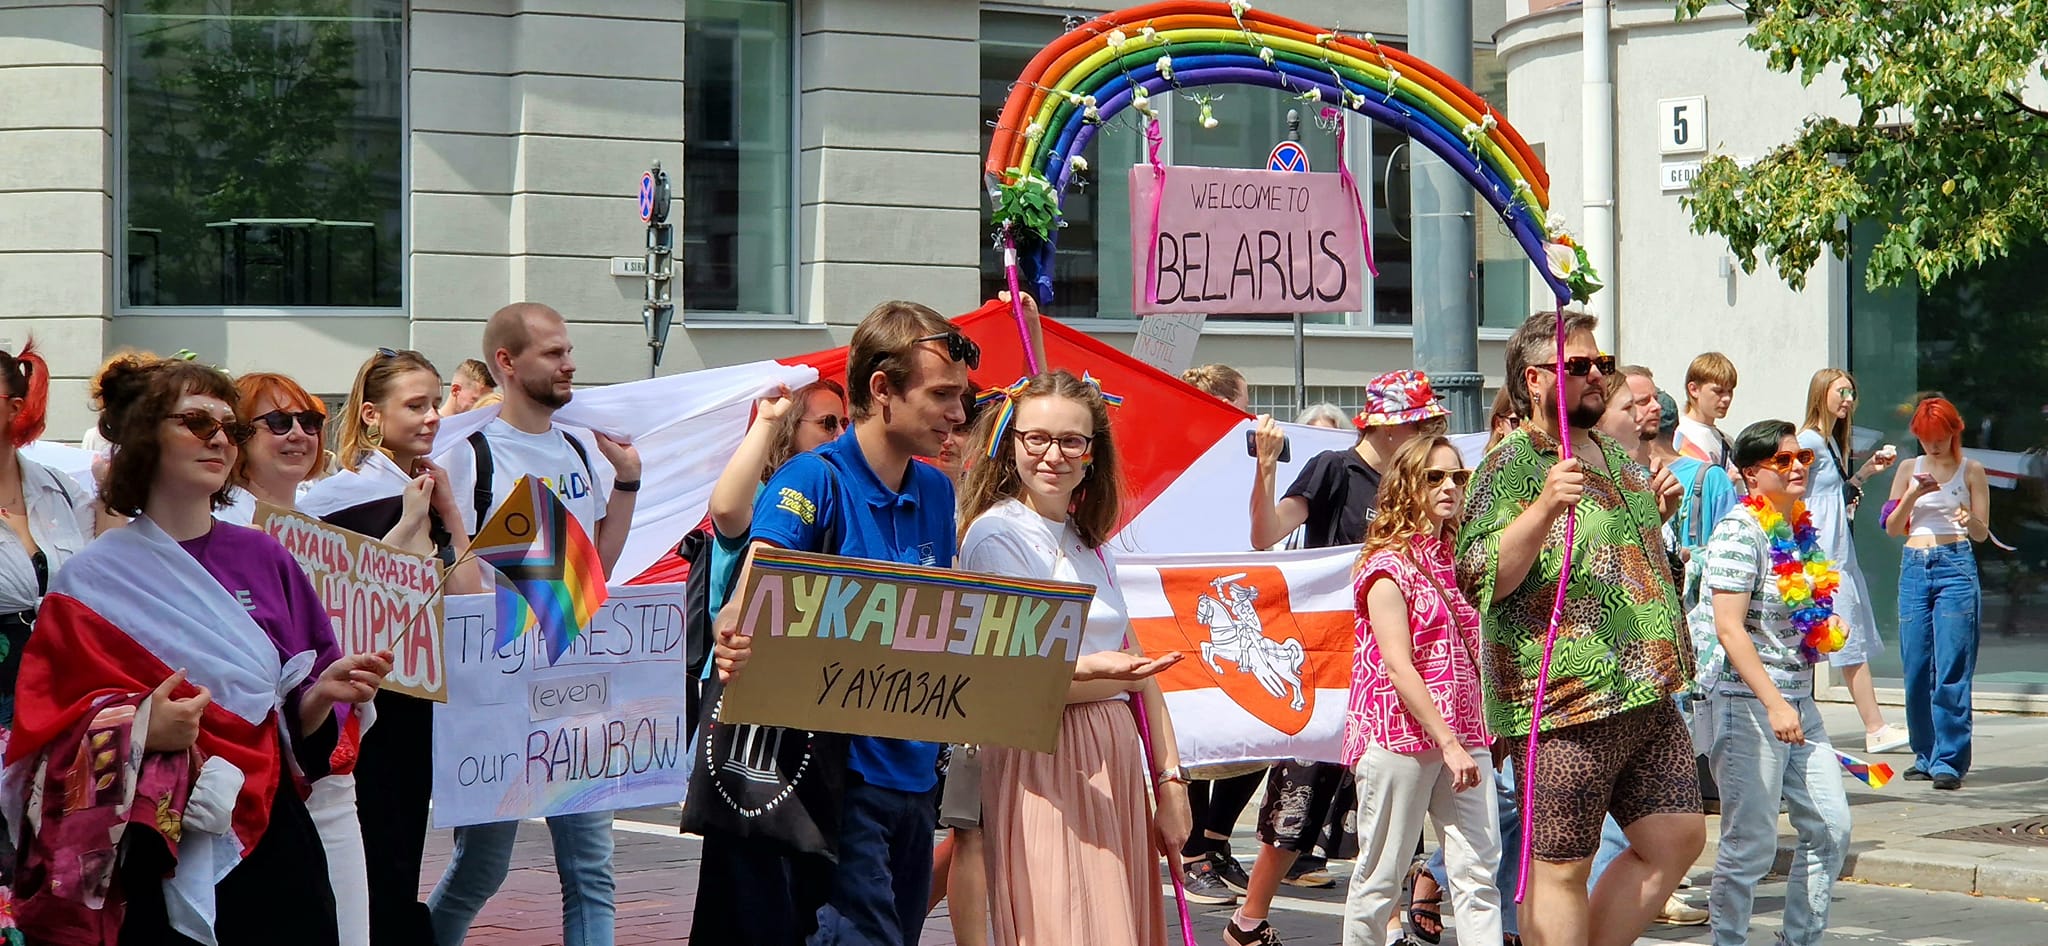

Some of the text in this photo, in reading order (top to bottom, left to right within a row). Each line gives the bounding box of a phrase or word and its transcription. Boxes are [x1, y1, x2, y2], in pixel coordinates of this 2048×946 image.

[1673, 105, 1689, 145] 5
[1191, 183, 1310, 212] WELCOME TO
[1671, 168, 1700, 182] GEDI
[1156, 229, 1347, 304] BELARUS
[1141, 316, 1179, 343] RIGHTS
[268, 516, 350, 575] КАХАЦЬ
[360, 546, 435, 595] ЛЮДЗЕЙ
[325, 578, 436, 686] НОРМА
[536, 603, 685, 656] ESTED
[740, 574, 1082, 662] ЛУКАШЭНКА
[532, 676, 609, 712] (even)
[841, 664, 971, 719] АЎТАЗАК
[458, 716, 680, 787] our RAINBOW
[706, 734, 716, 776] SCHOOL
[766, 753, 811, 811] BELARUSIAN
